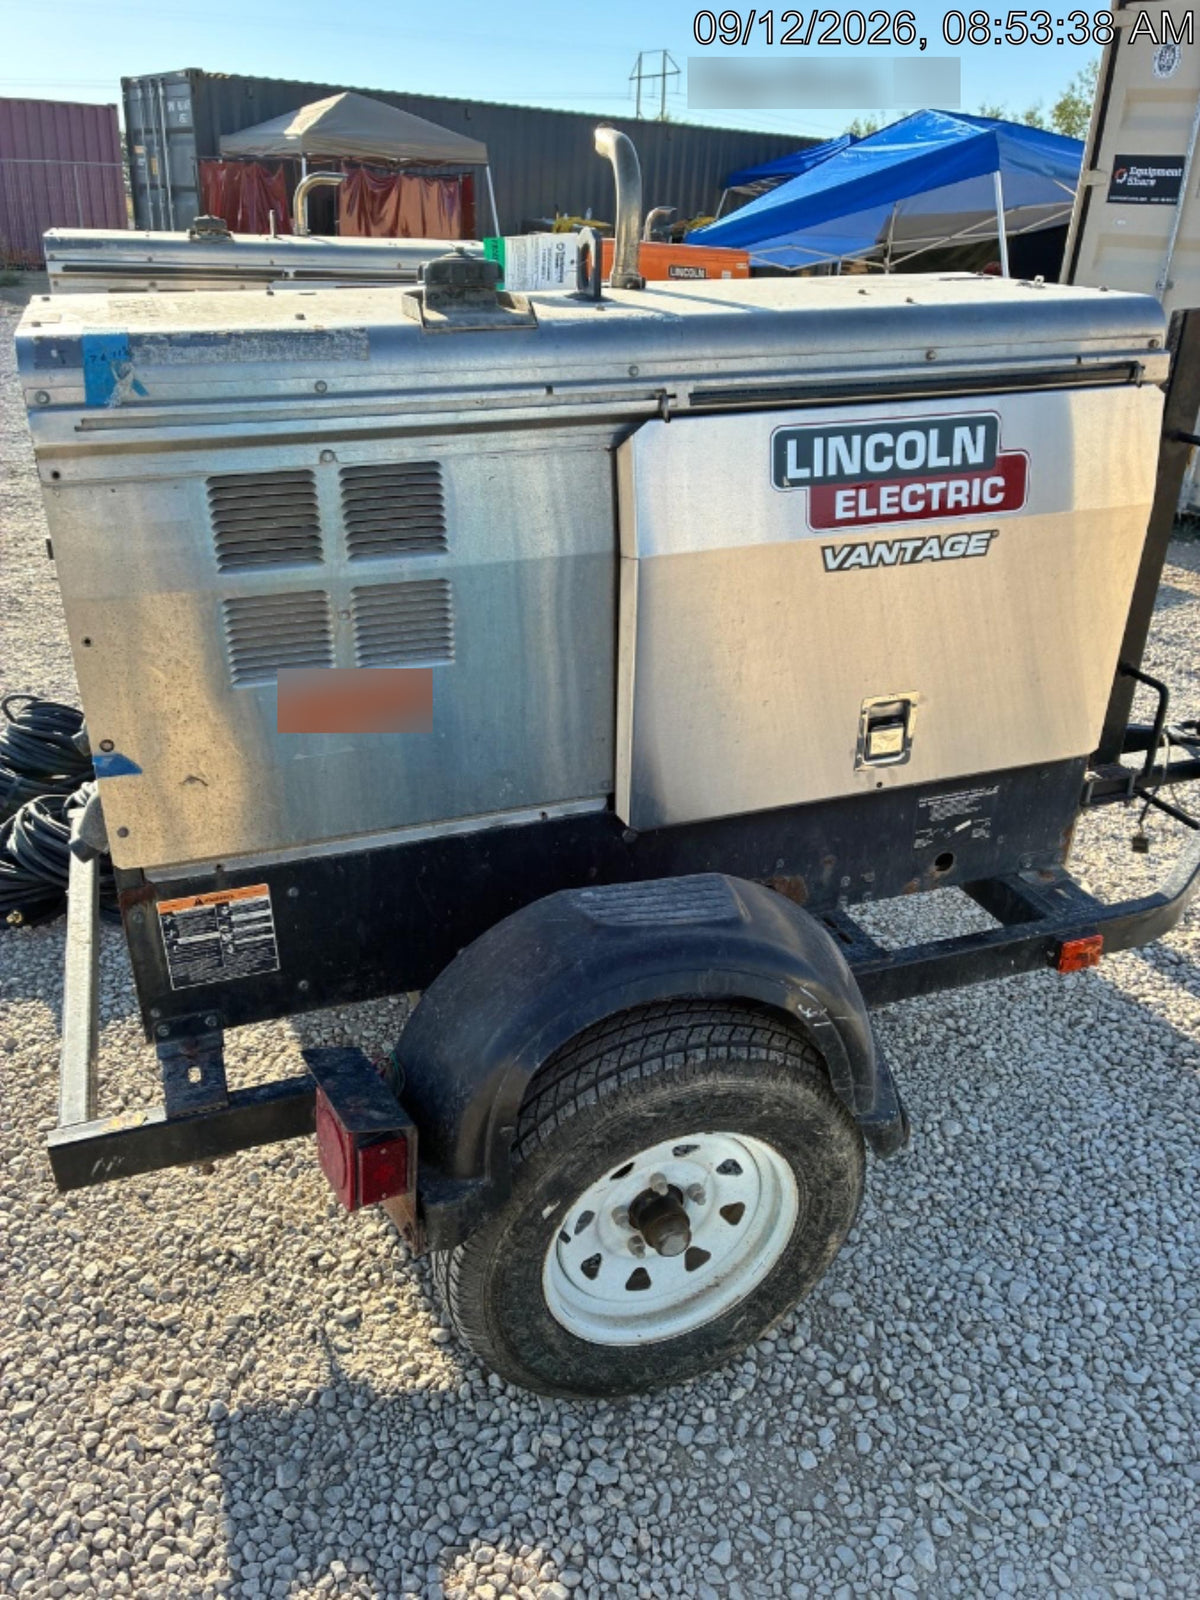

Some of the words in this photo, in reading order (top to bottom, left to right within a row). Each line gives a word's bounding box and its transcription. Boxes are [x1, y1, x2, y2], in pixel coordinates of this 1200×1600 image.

[1129, 166, 1183, 178] Equipment
[670, 266, 705, 279] LINCOLN
[786, 424, 986, 480] LINCOLN
[834, 475, 1006, 521] ELECTRIC
